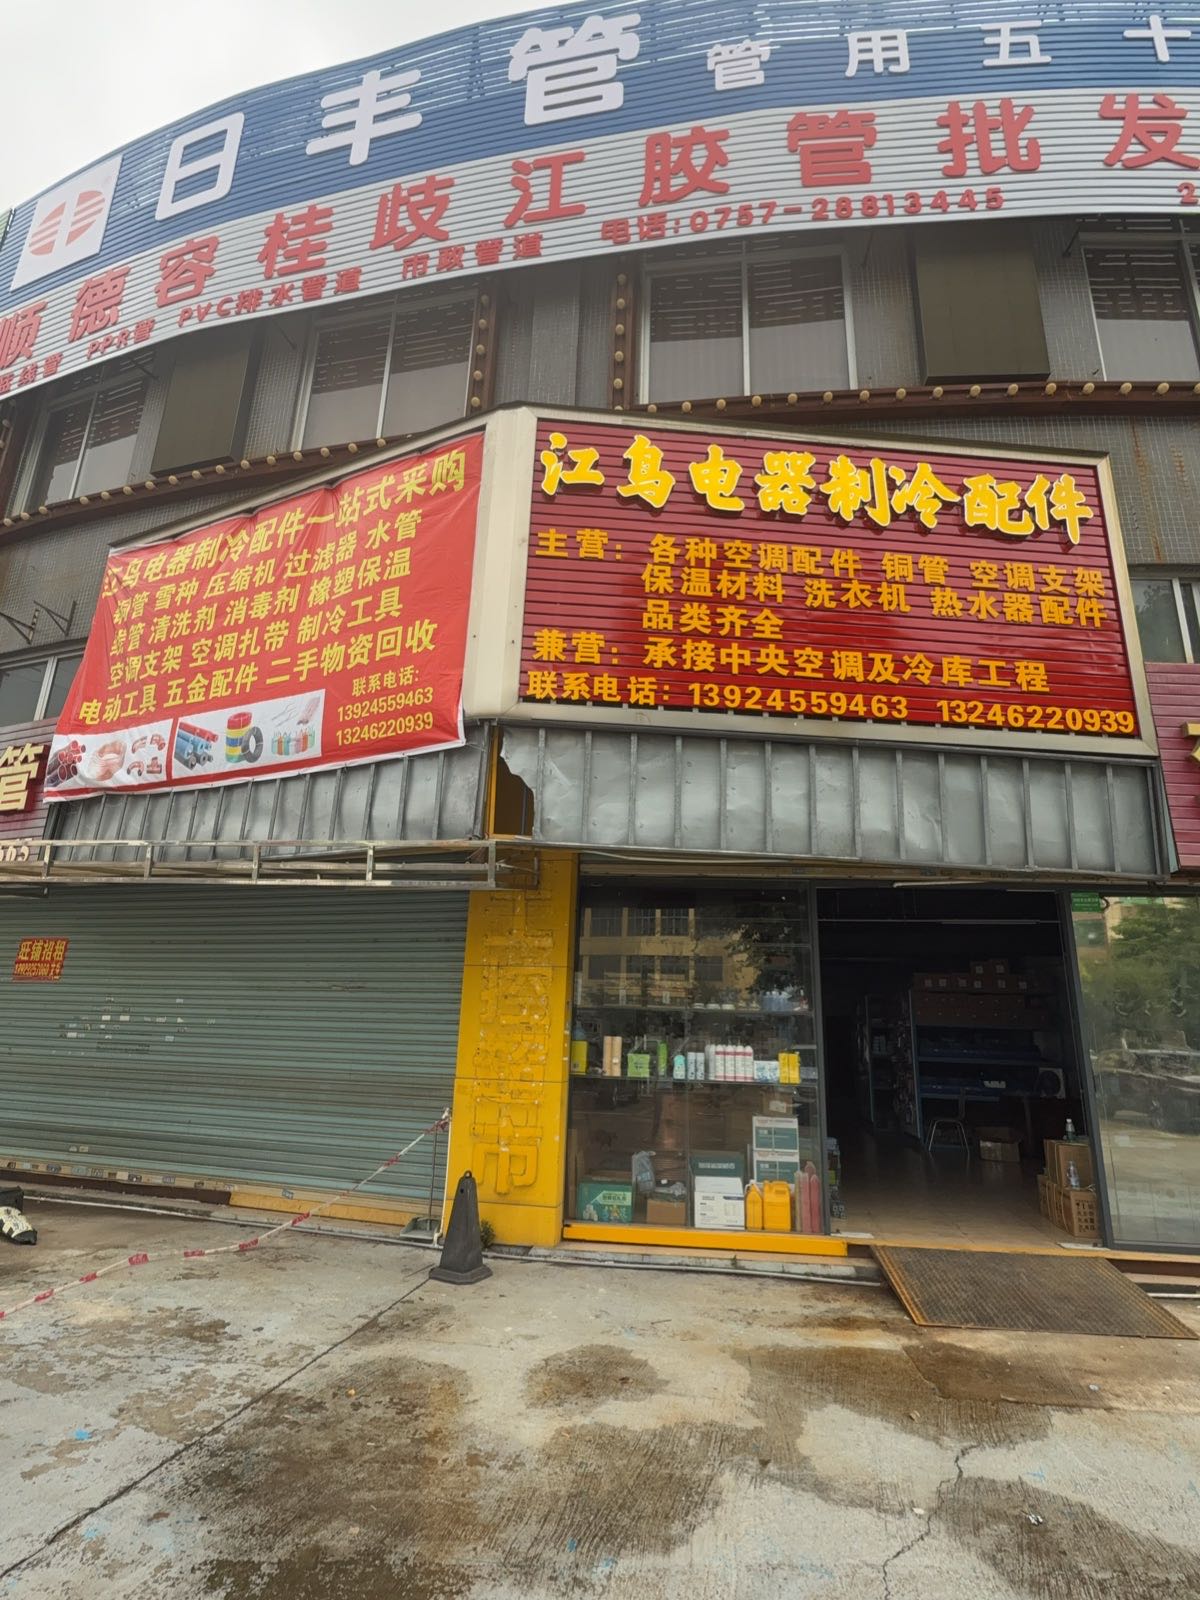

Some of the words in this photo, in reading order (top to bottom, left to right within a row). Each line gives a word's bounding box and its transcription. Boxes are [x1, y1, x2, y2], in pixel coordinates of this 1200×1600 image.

[154, 14, 641, 220] 日丰管
[706, 14, 1191, 91] 管用五十
[87, 317, 155, 360] PPR管
[177, 266, 363, 328] PVC排水管道
[401, 232, 543, 281] 市政管道
[154, 577, 200, 611] 雪种
[203, 558, 276, 600] 压缩机
[283, 531, 358, 579] 过滤器
[365, 508, 423, 550] 水管
[648, 533, 863, 578] 各种空调配件
[881, 551, 949, 586] 铜管
[970, 560, 1106, 597] 空调支架
[148, 602, 219, 644] 清洗剂
[223, 584, 300, 626] 消毒剂
[307, 547, 411, 608] 橡塑保温
[641, 563, 786, 604] 保温材料
[804, 579, 912, 614] 洗衣机
[930, 586, 1108, 628] 热水器配件
[642, 599, 785, 640] 品类齐全
[108, 645, 183, 690] 空调支架
[189, 618, 290, 668] 空调扎带
[297, 586, 404, 645] 制冷工具
[642, 636, 1051, 694] 承接中央空调及冷库工程
[79, 683, 158, 725] 电动工具
[163, 661, 258, 708] 五金配件
[266, 618, 438, 685] 二手物资回收
[337, 686, 434, 722] 13924559463
[336, 711, 434, 746] 13246220939
[688, 682, 909, 720] 13924559463
[936, 699, 1135, 734] 13246220939
